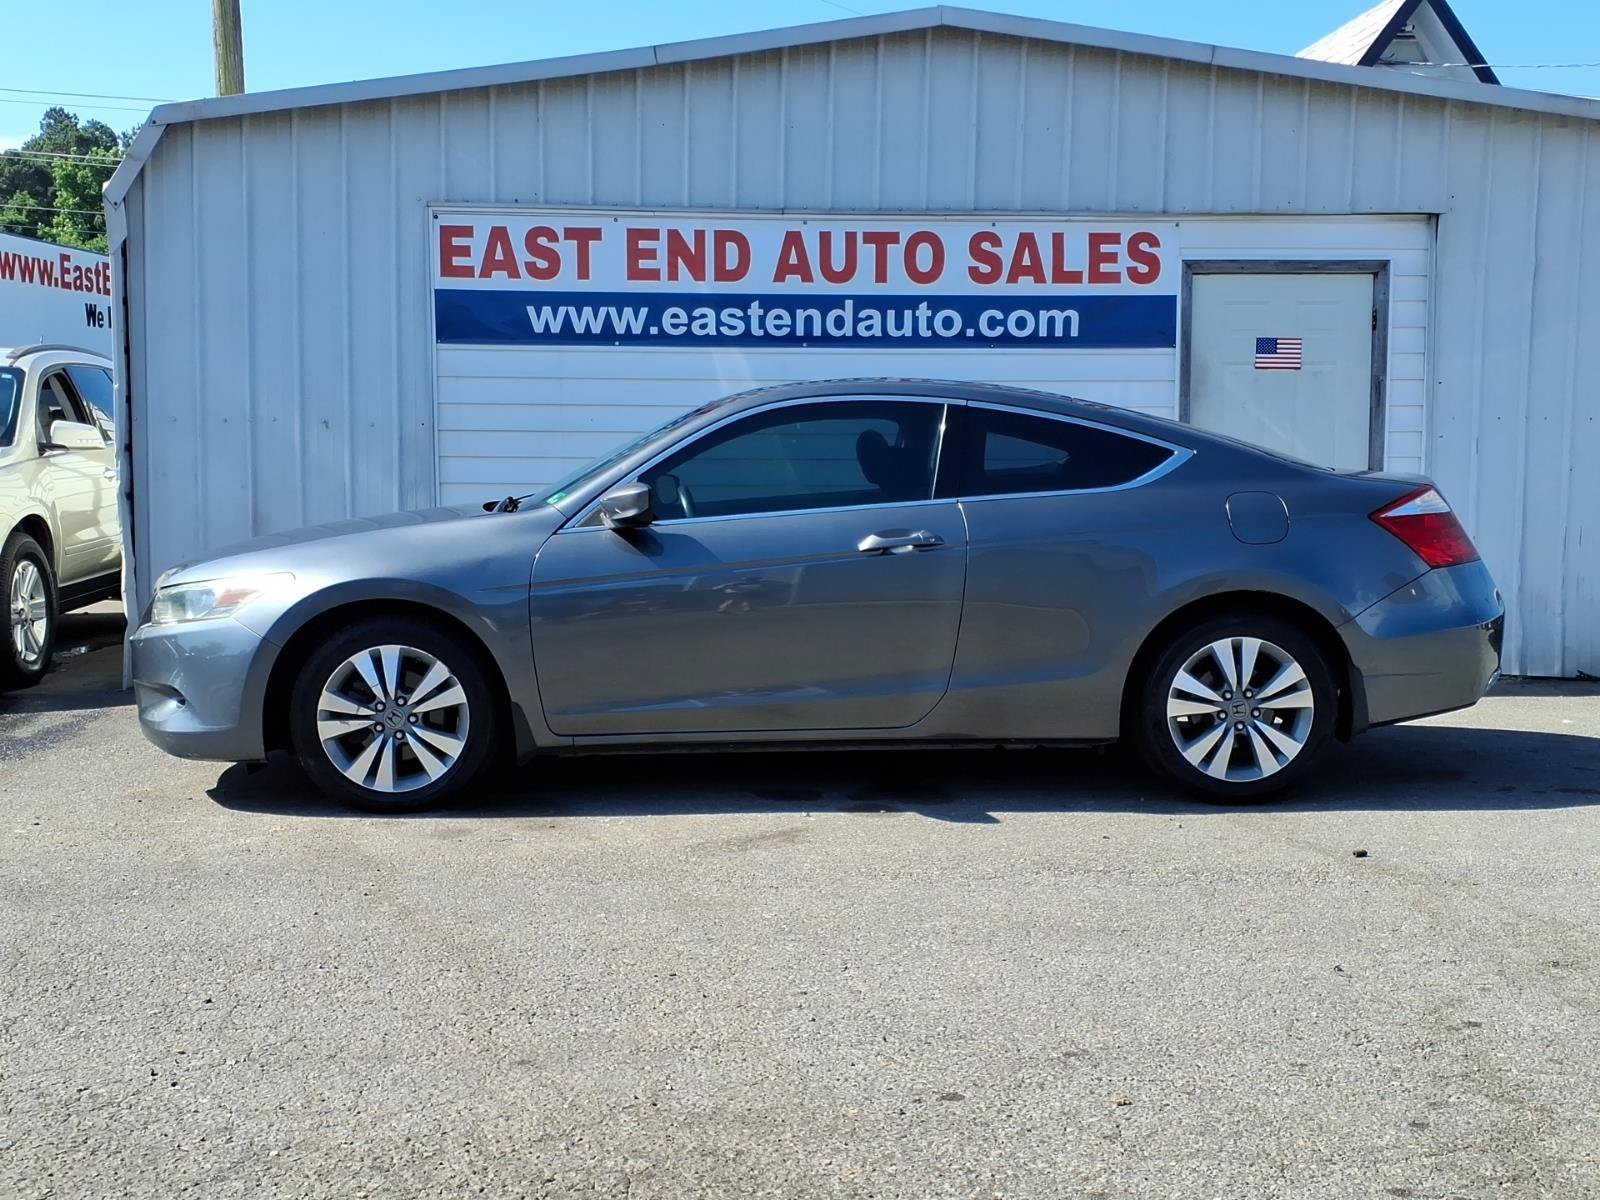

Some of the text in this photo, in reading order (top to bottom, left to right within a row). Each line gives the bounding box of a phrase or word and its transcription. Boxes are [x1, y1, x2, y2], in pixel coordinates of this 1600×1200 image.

[439, 225, 1162, 285] EAST END AUTO SALES
[84, 302, 104, 329] We
[526, 299, 1080, 338] www.eastendauto.com
